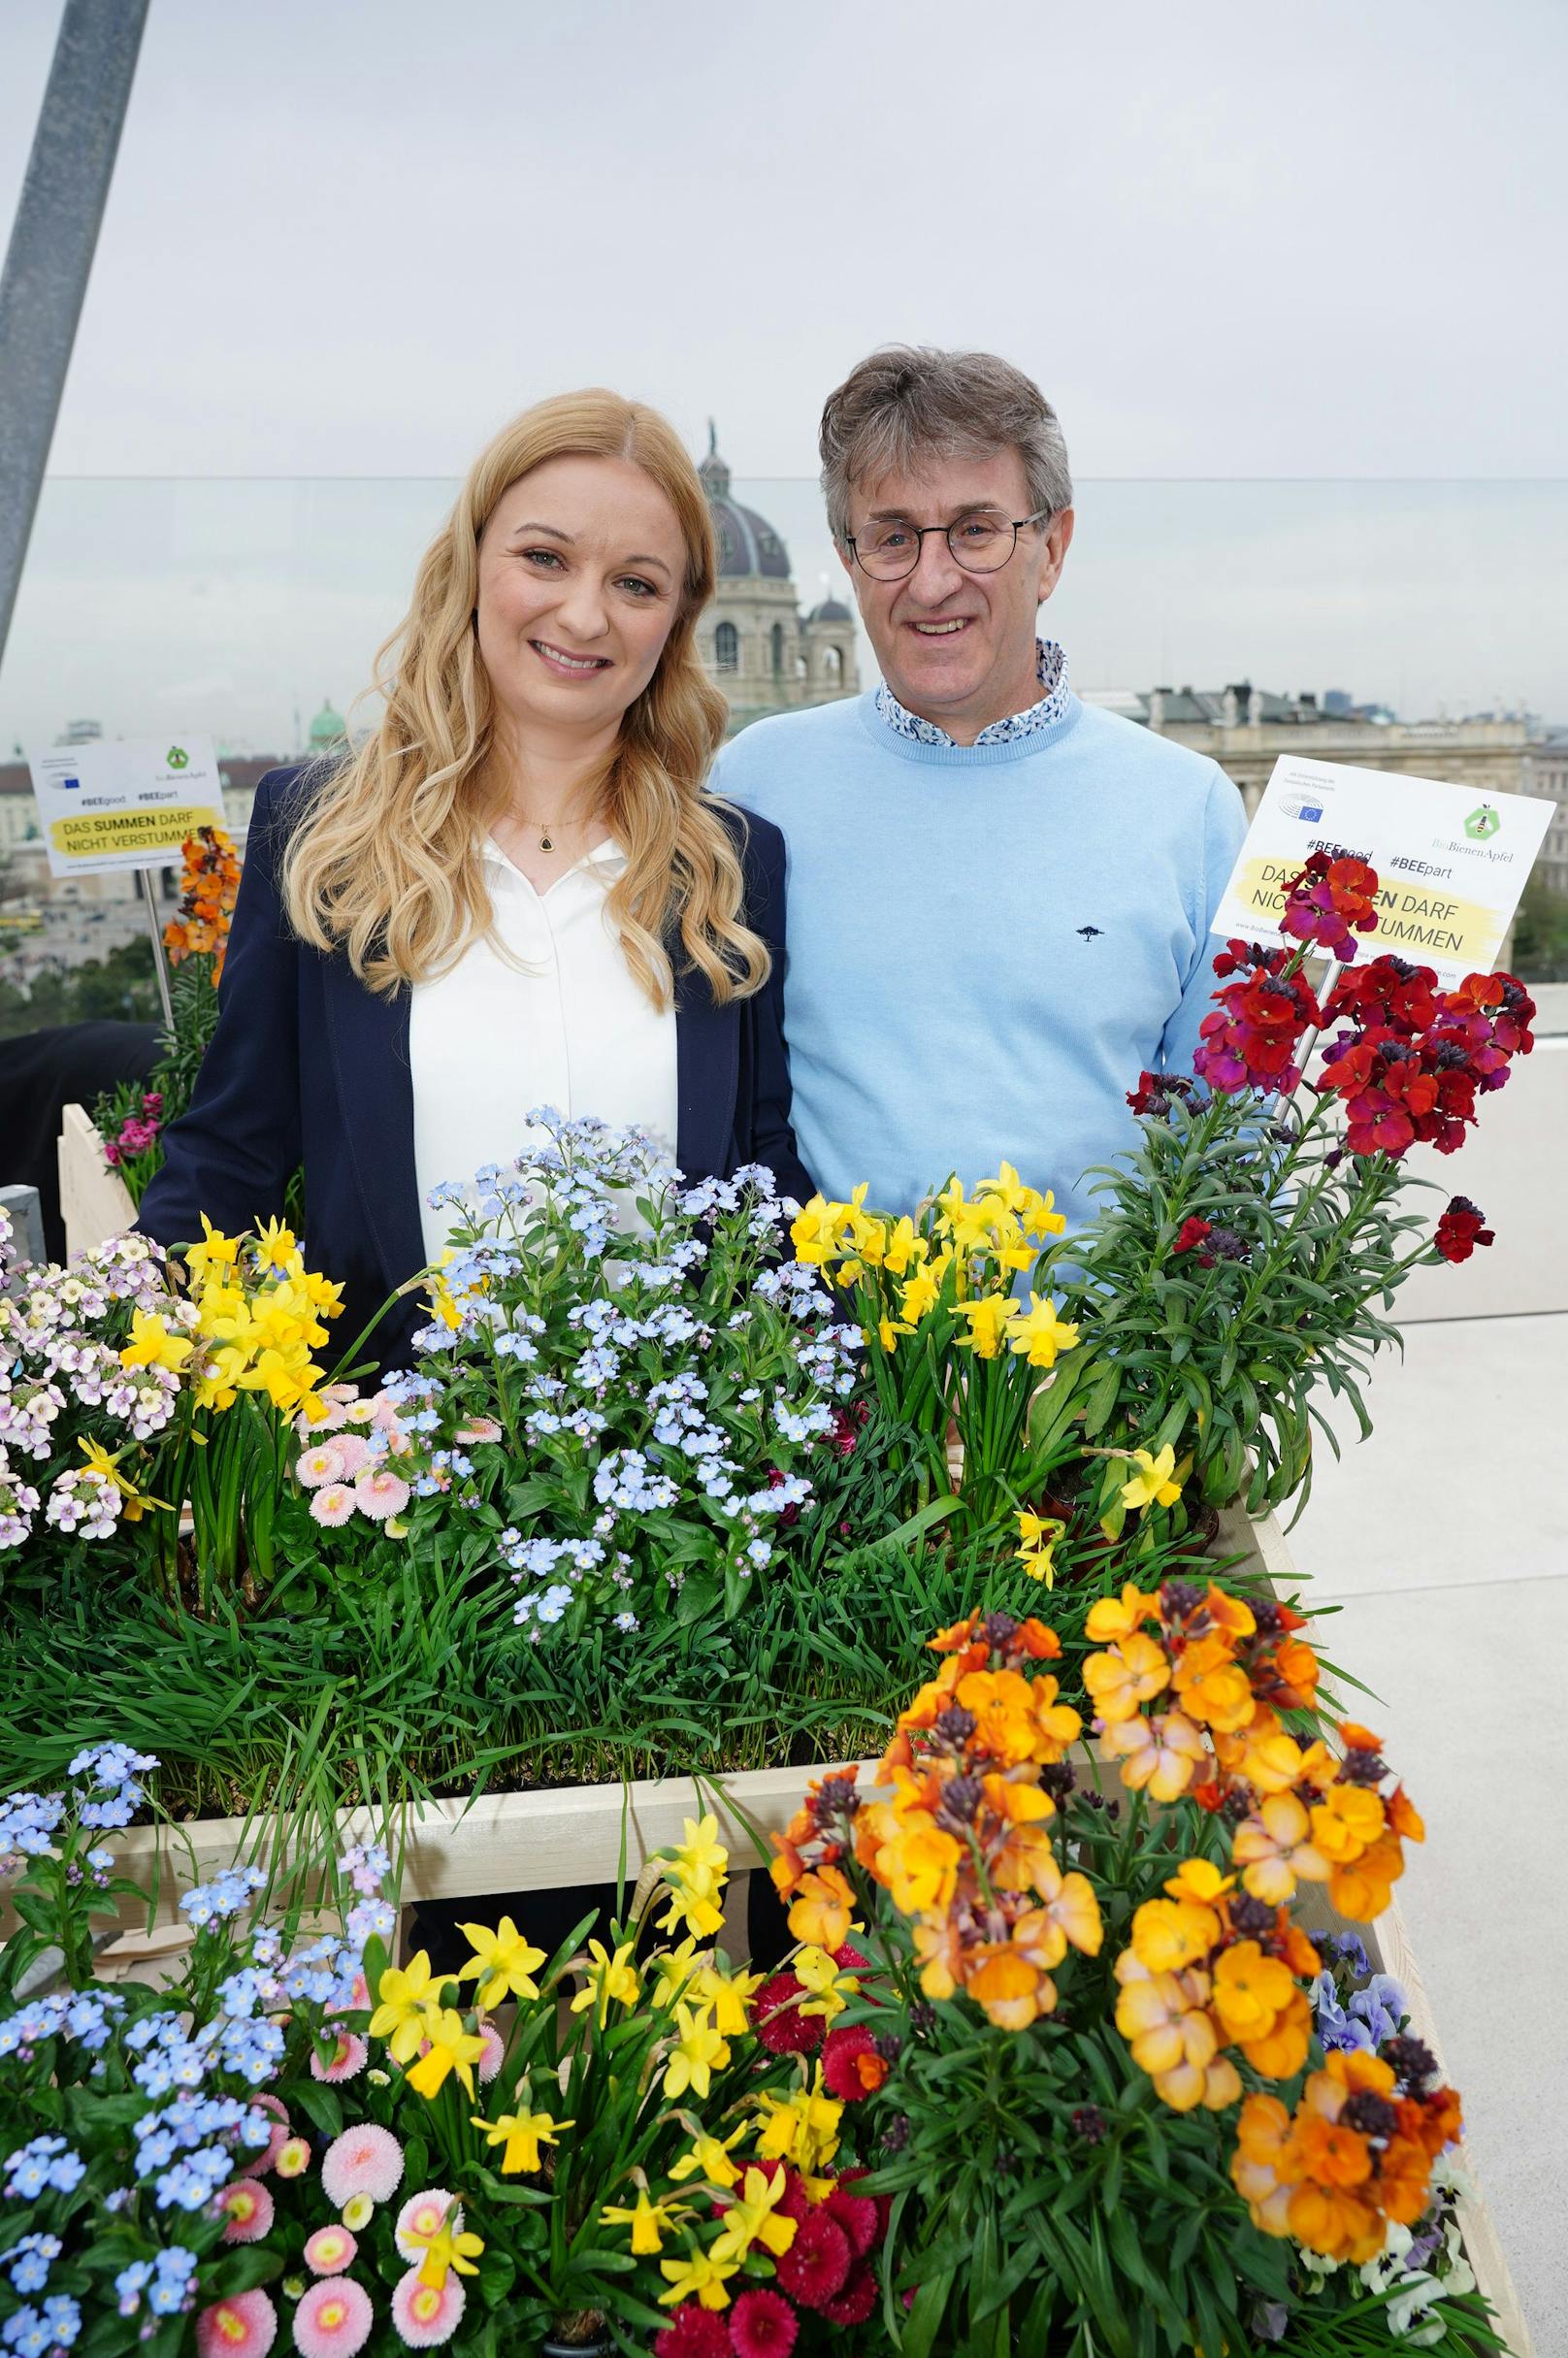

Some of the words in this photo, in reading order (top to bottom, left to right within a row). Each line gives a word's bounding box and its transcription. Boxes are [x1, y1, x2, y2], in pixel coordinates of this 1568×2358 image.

[138, 790, 179, 802] #BEEpart
[63, 822, 91, 835] DAS
[94, 815, 155, 832] SUMMEN
[159, 811, 194, 826] DARF
[67, 836, 108, 852] NICHT
[112, 828, 198, 848] VERSTUMME
[1389, 856, 1453, 879] #BEEpart
[1401, 896, 1459, 921] DARF
